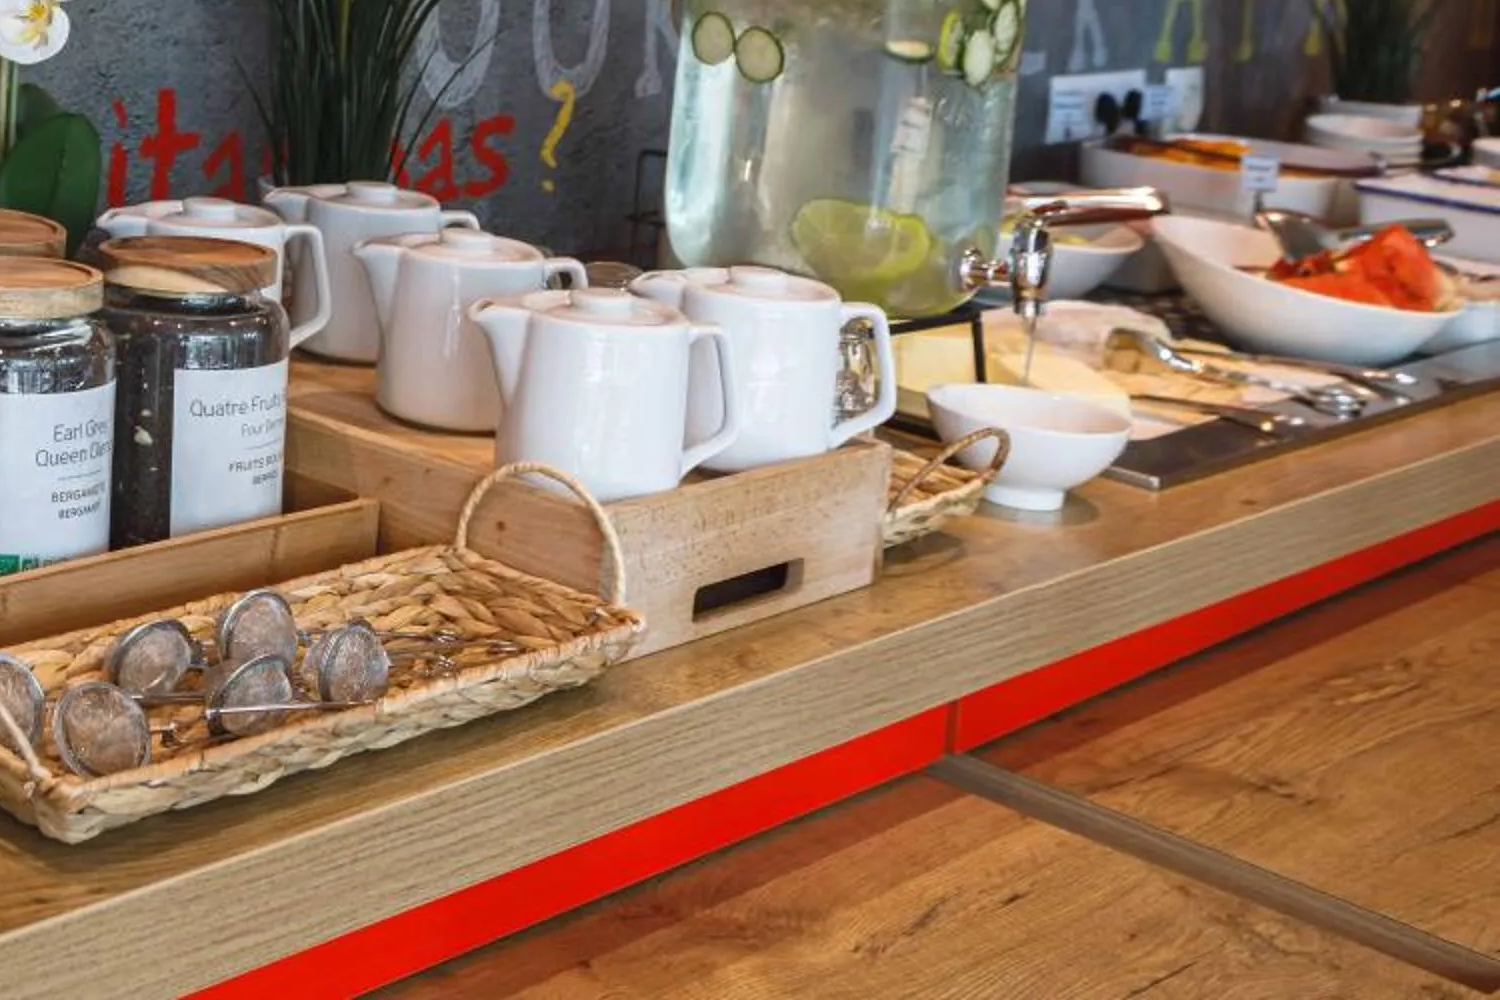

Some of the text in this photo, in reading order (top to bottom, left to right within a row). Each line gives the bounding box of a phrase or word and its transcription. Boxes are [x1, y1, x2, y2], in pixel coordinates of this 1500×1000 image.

[189, 396, 249, 417] Quatre
[52, 422, 83, 443] Earl
[35, 448, 88, 468] Queen
